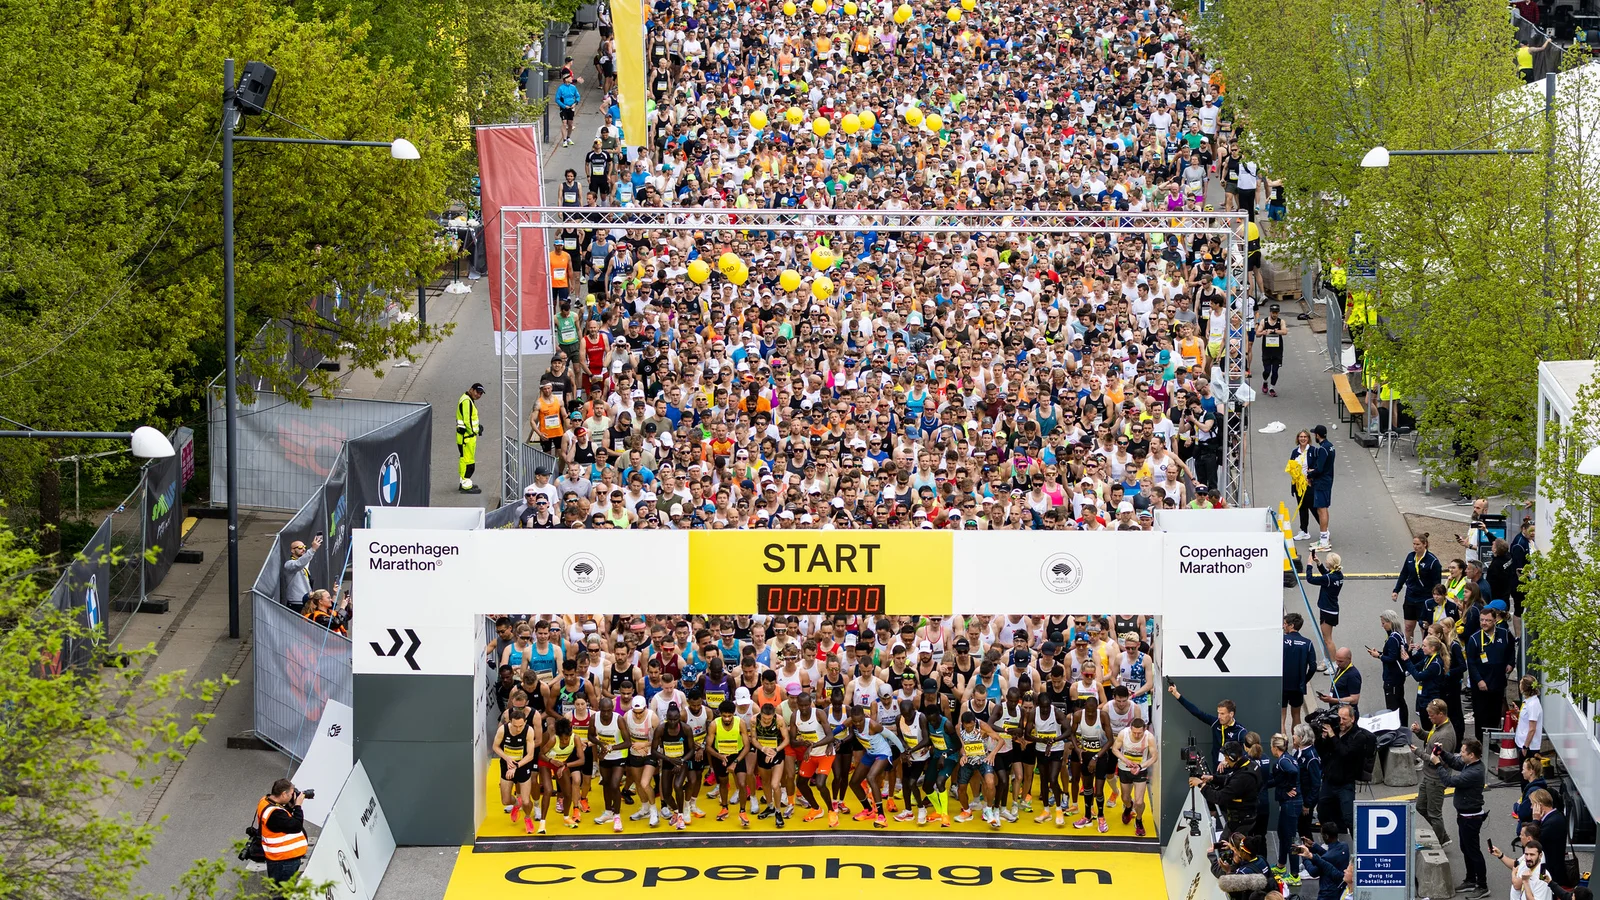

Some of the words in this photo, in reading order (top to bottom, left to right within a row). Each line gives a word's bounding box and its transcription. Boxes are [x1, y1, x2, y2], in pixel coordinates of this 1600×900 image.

[369, 541, 459, 557] Copenhagen
[763, 543, 881, 573] START
[1180, 545, 1269, 561] Copenhagen
[767, 587, 880, 612] 00:00:00
[1125, 682, 1137, 691] Fry
[1083, 741, 1100, 749] PACE
[1368, 808, 1398, 850] P
[504, 857, 1113, 888] Copenhagen
